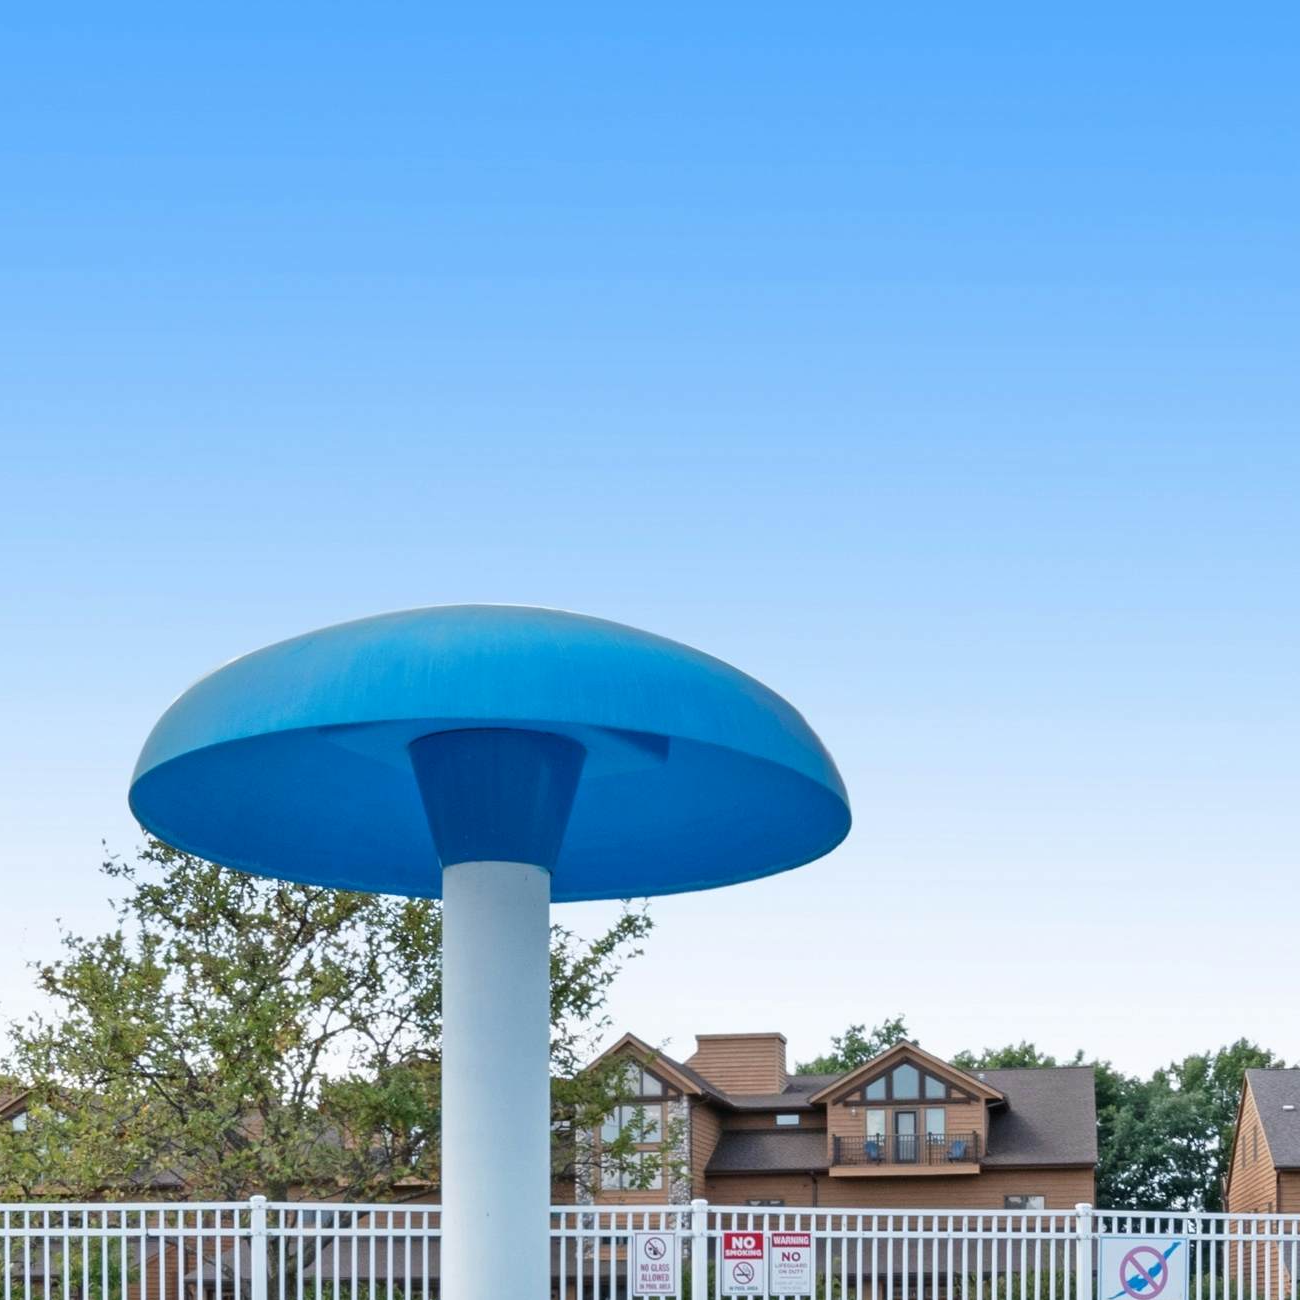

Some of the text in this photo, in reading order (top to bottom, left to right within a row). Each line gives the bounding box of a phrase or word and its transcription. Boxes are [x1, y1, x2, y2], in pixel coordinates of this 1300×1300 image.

[732, 1237, 755, 1249] NO
[773, 1236, 809, 1245] WARNING
[782, 1252, 800, 1261] NO
[640, 1264, 670, 1272] NO GLASS
